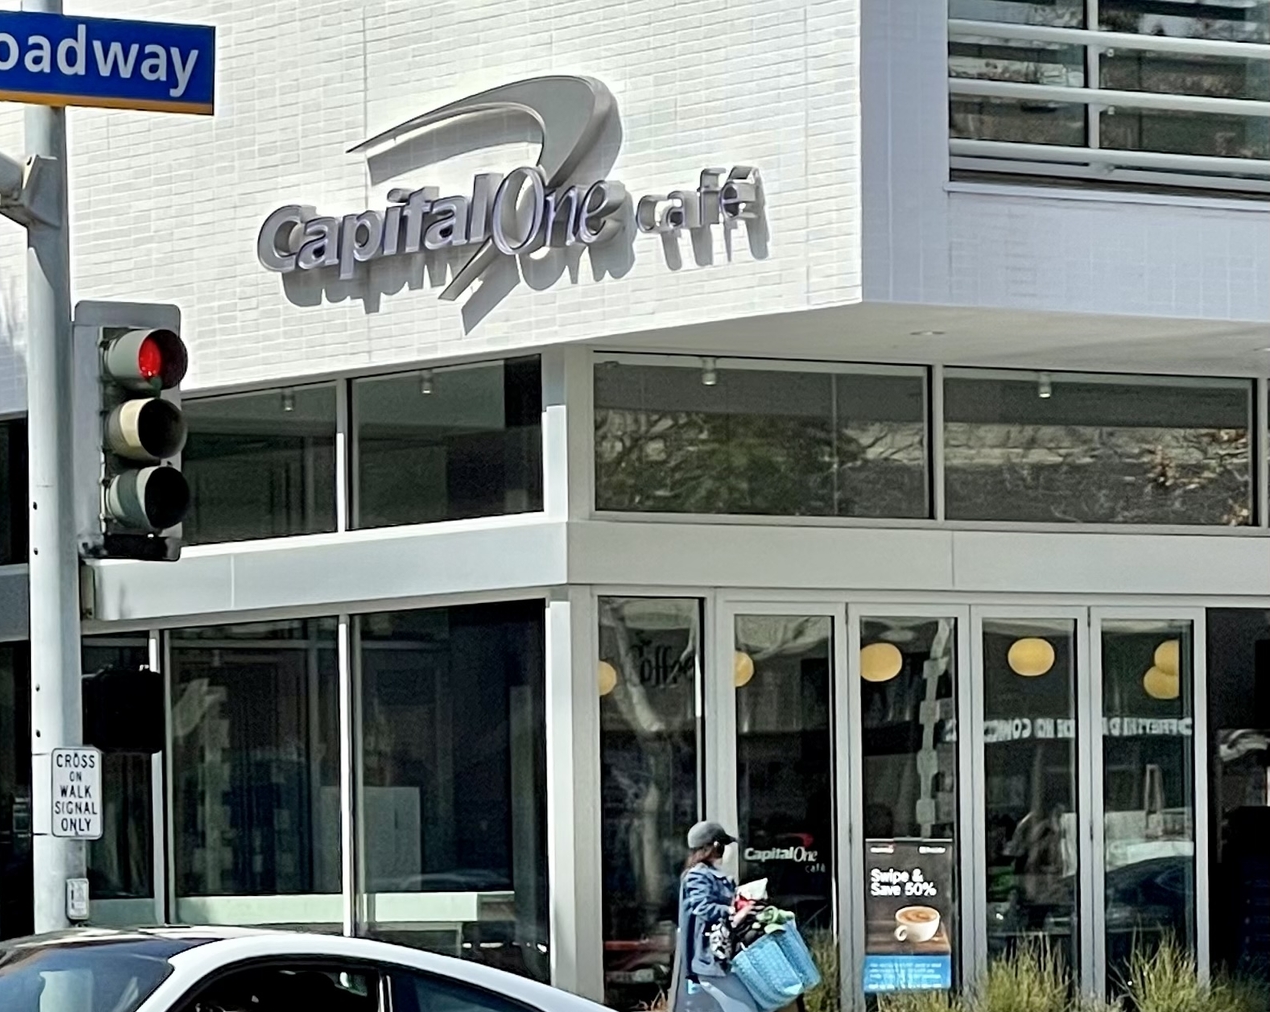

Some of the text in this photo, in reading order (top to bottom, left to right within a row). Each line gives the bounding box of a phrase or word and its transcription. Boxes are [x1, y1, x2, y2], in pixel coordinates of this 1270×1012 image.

[56, 753, 96, 768] CROSS
[69, 771, 82, 782] ON
[60, 785, 91, 798] WALK
[54, 801, 98, 815] SIGNAL
[61, 818, 91, 832] ONLY
[870, 868, 924, 883] Swipe &
[870, 882, 937, 896] Save 50%
